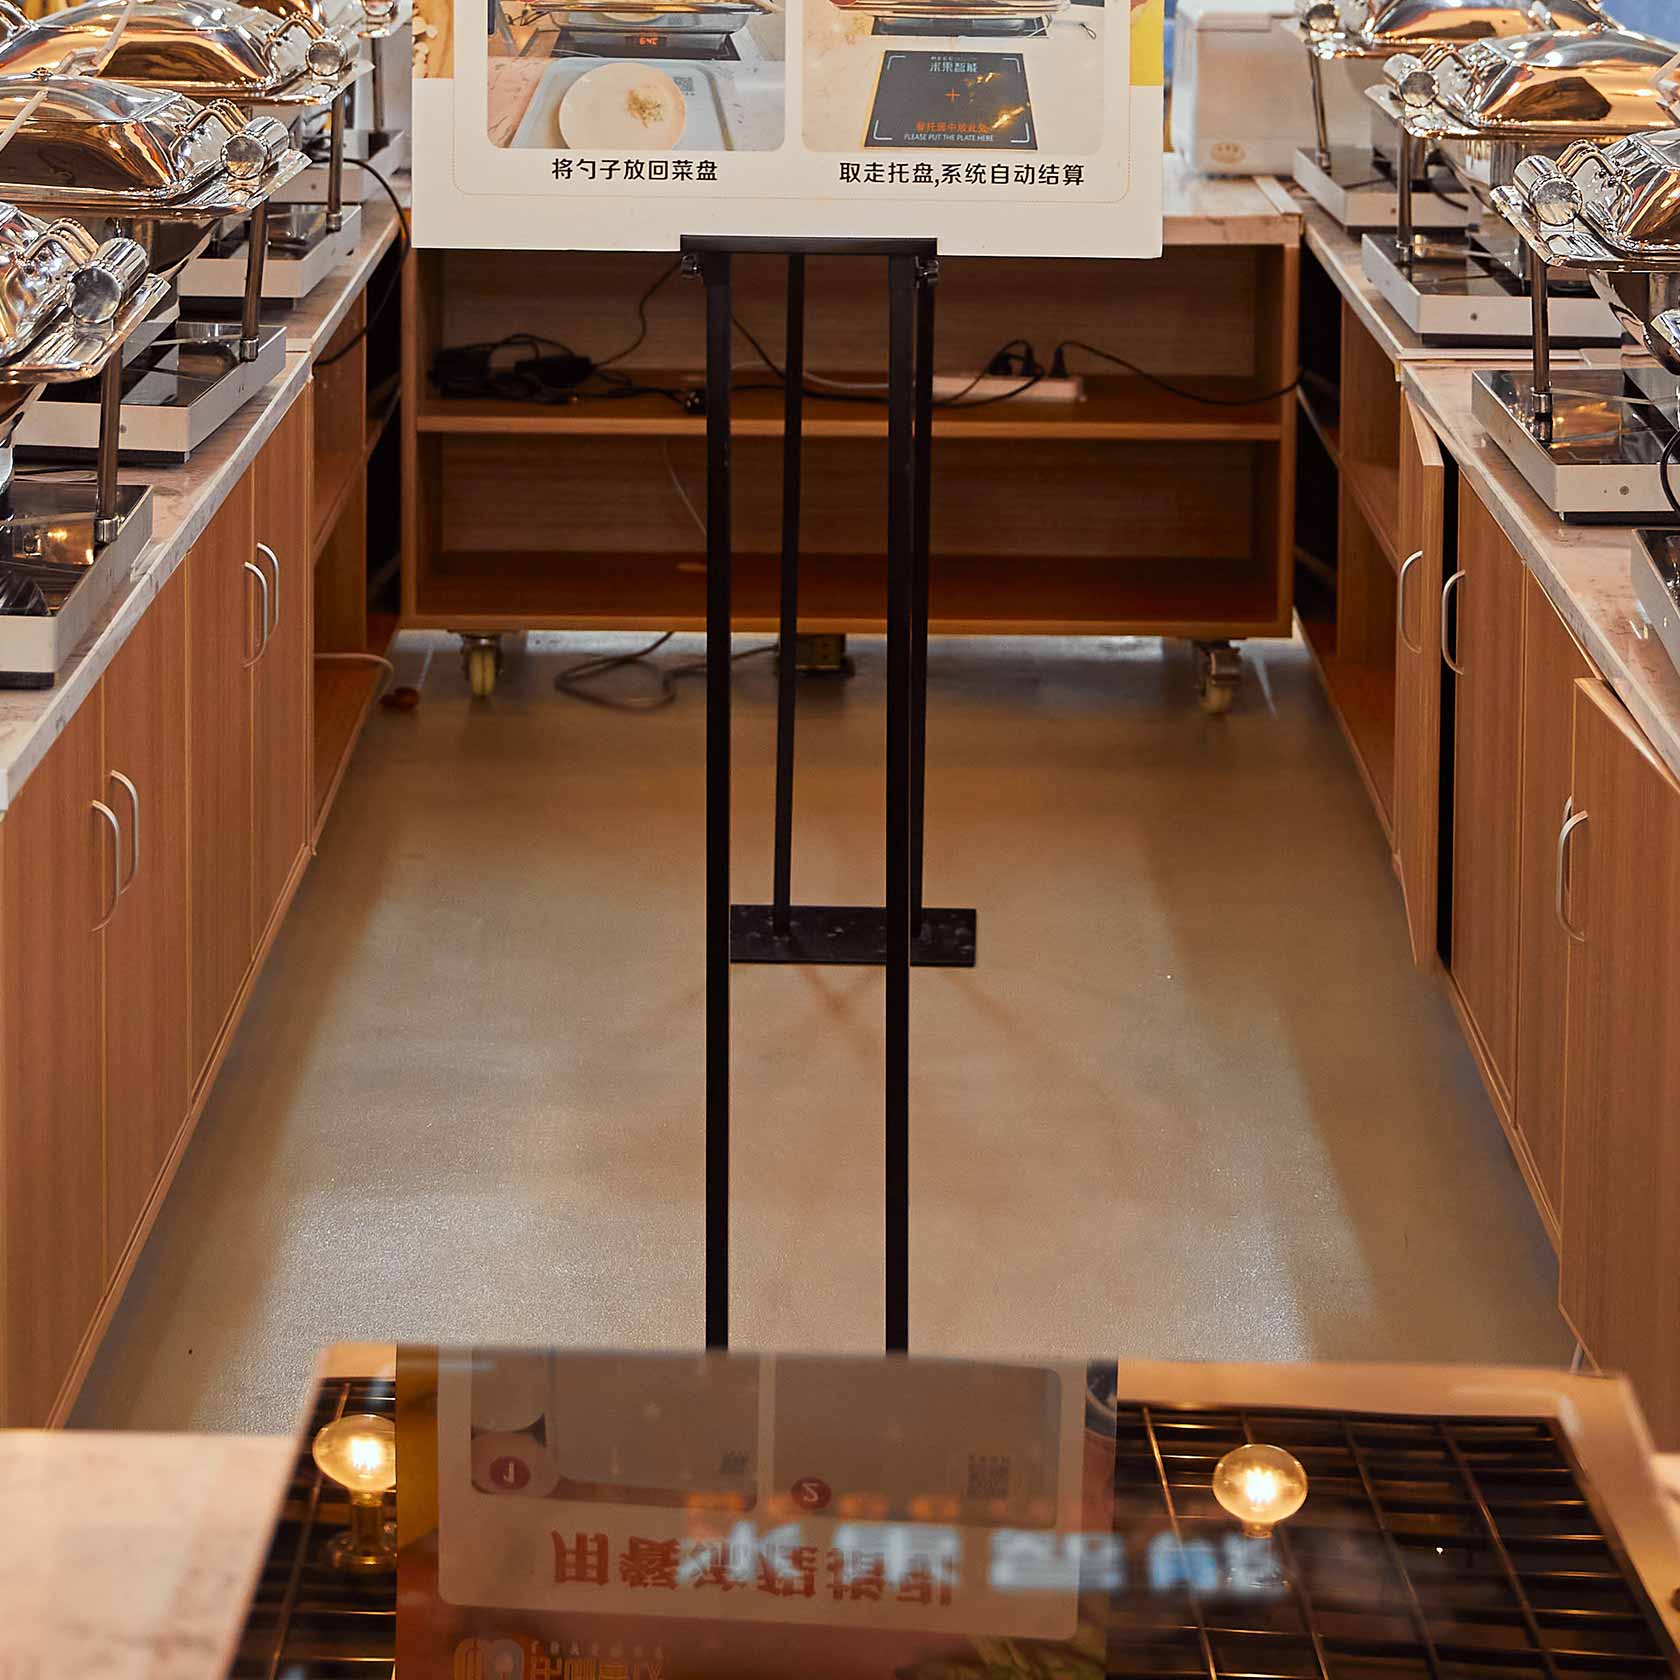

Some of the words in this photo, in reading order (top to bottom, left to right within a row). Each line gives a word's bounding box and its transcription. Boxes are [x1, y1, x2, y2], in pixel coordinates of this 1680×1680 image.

[551, 158, 719, 181] 将勺子放回菜盘
[839, 162, 1085, 188] 取走托盘,系统自动结算
